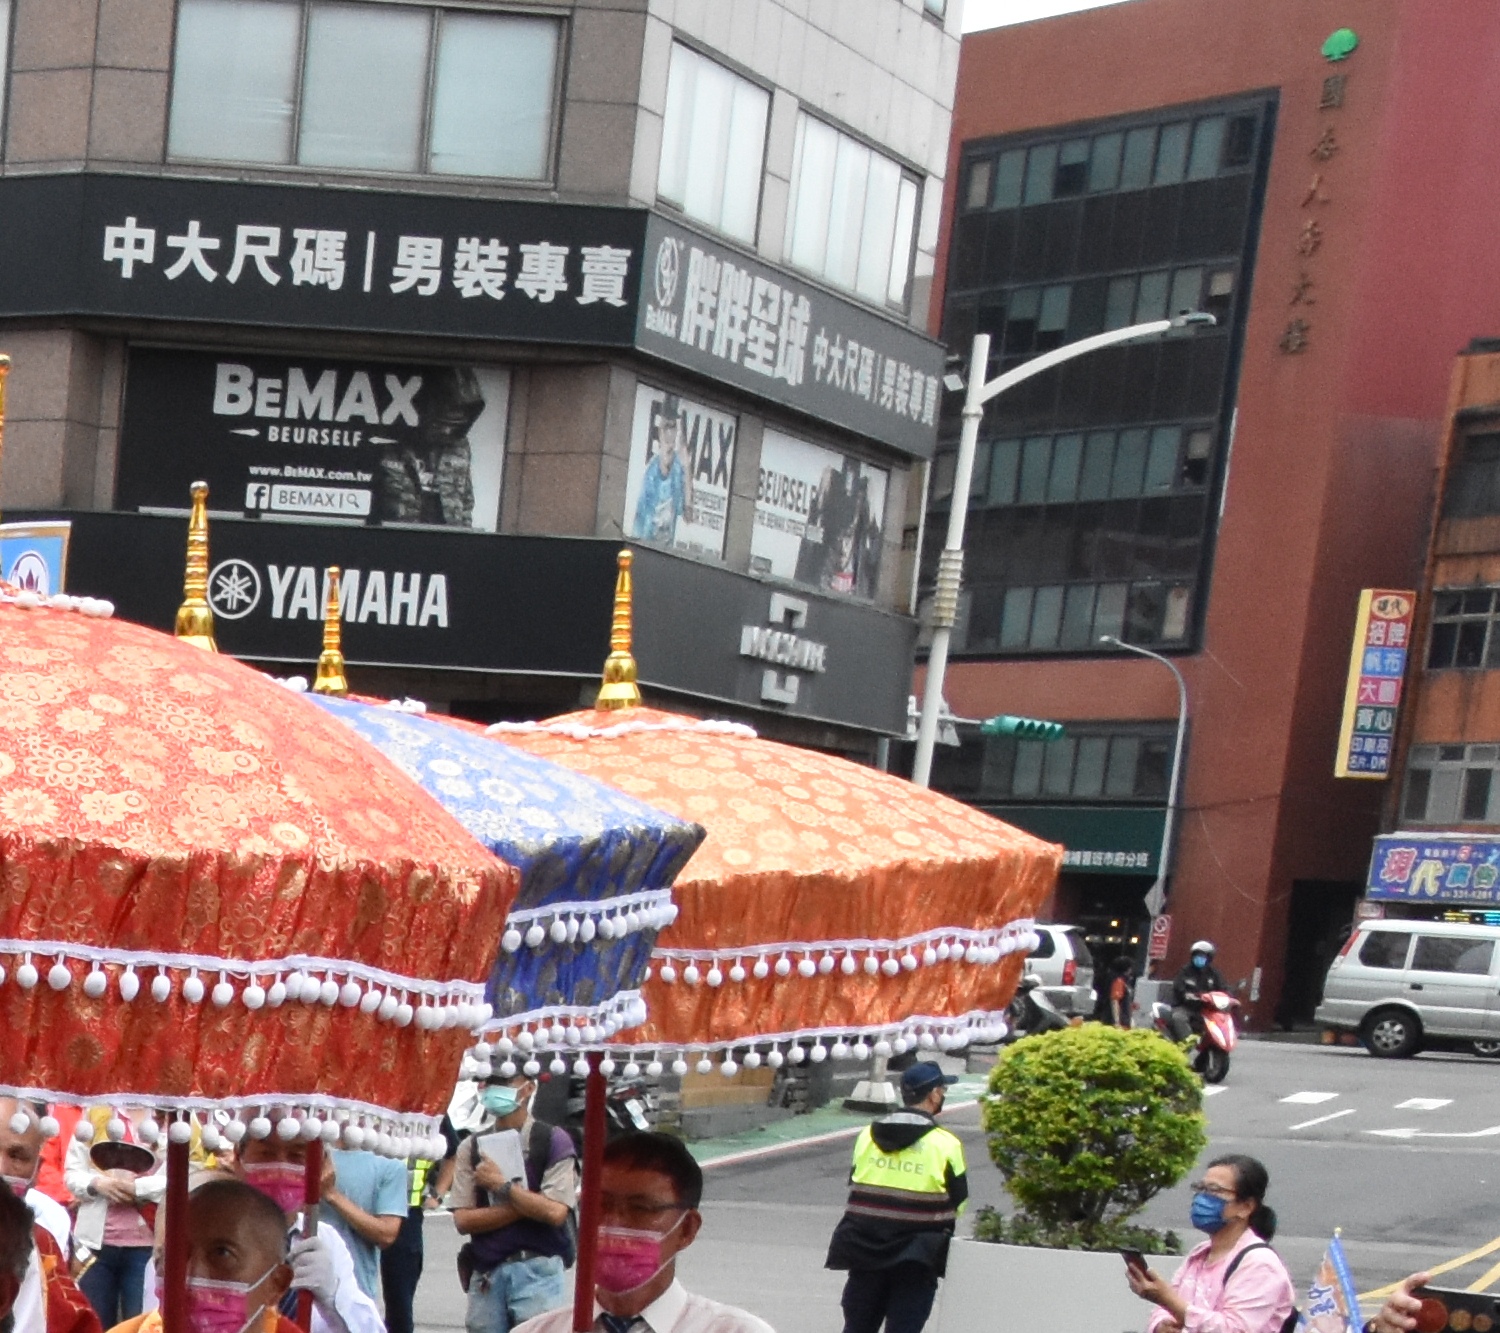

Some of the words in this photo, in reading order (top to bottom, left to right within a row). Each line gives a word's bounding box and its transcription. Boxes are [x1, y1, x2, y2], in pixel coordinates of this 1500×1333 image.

[103, 217, 347, 291] 中大尺碼
[390, 235, 632, 308] 男裝專賣
[679, 246, 811, 386] 胖胖星球
[267, 425, 362, 447] BEURSELF
[267, 564, 448, 627] YAMAHA
[868, 1156, 924, 1175] POLICE
